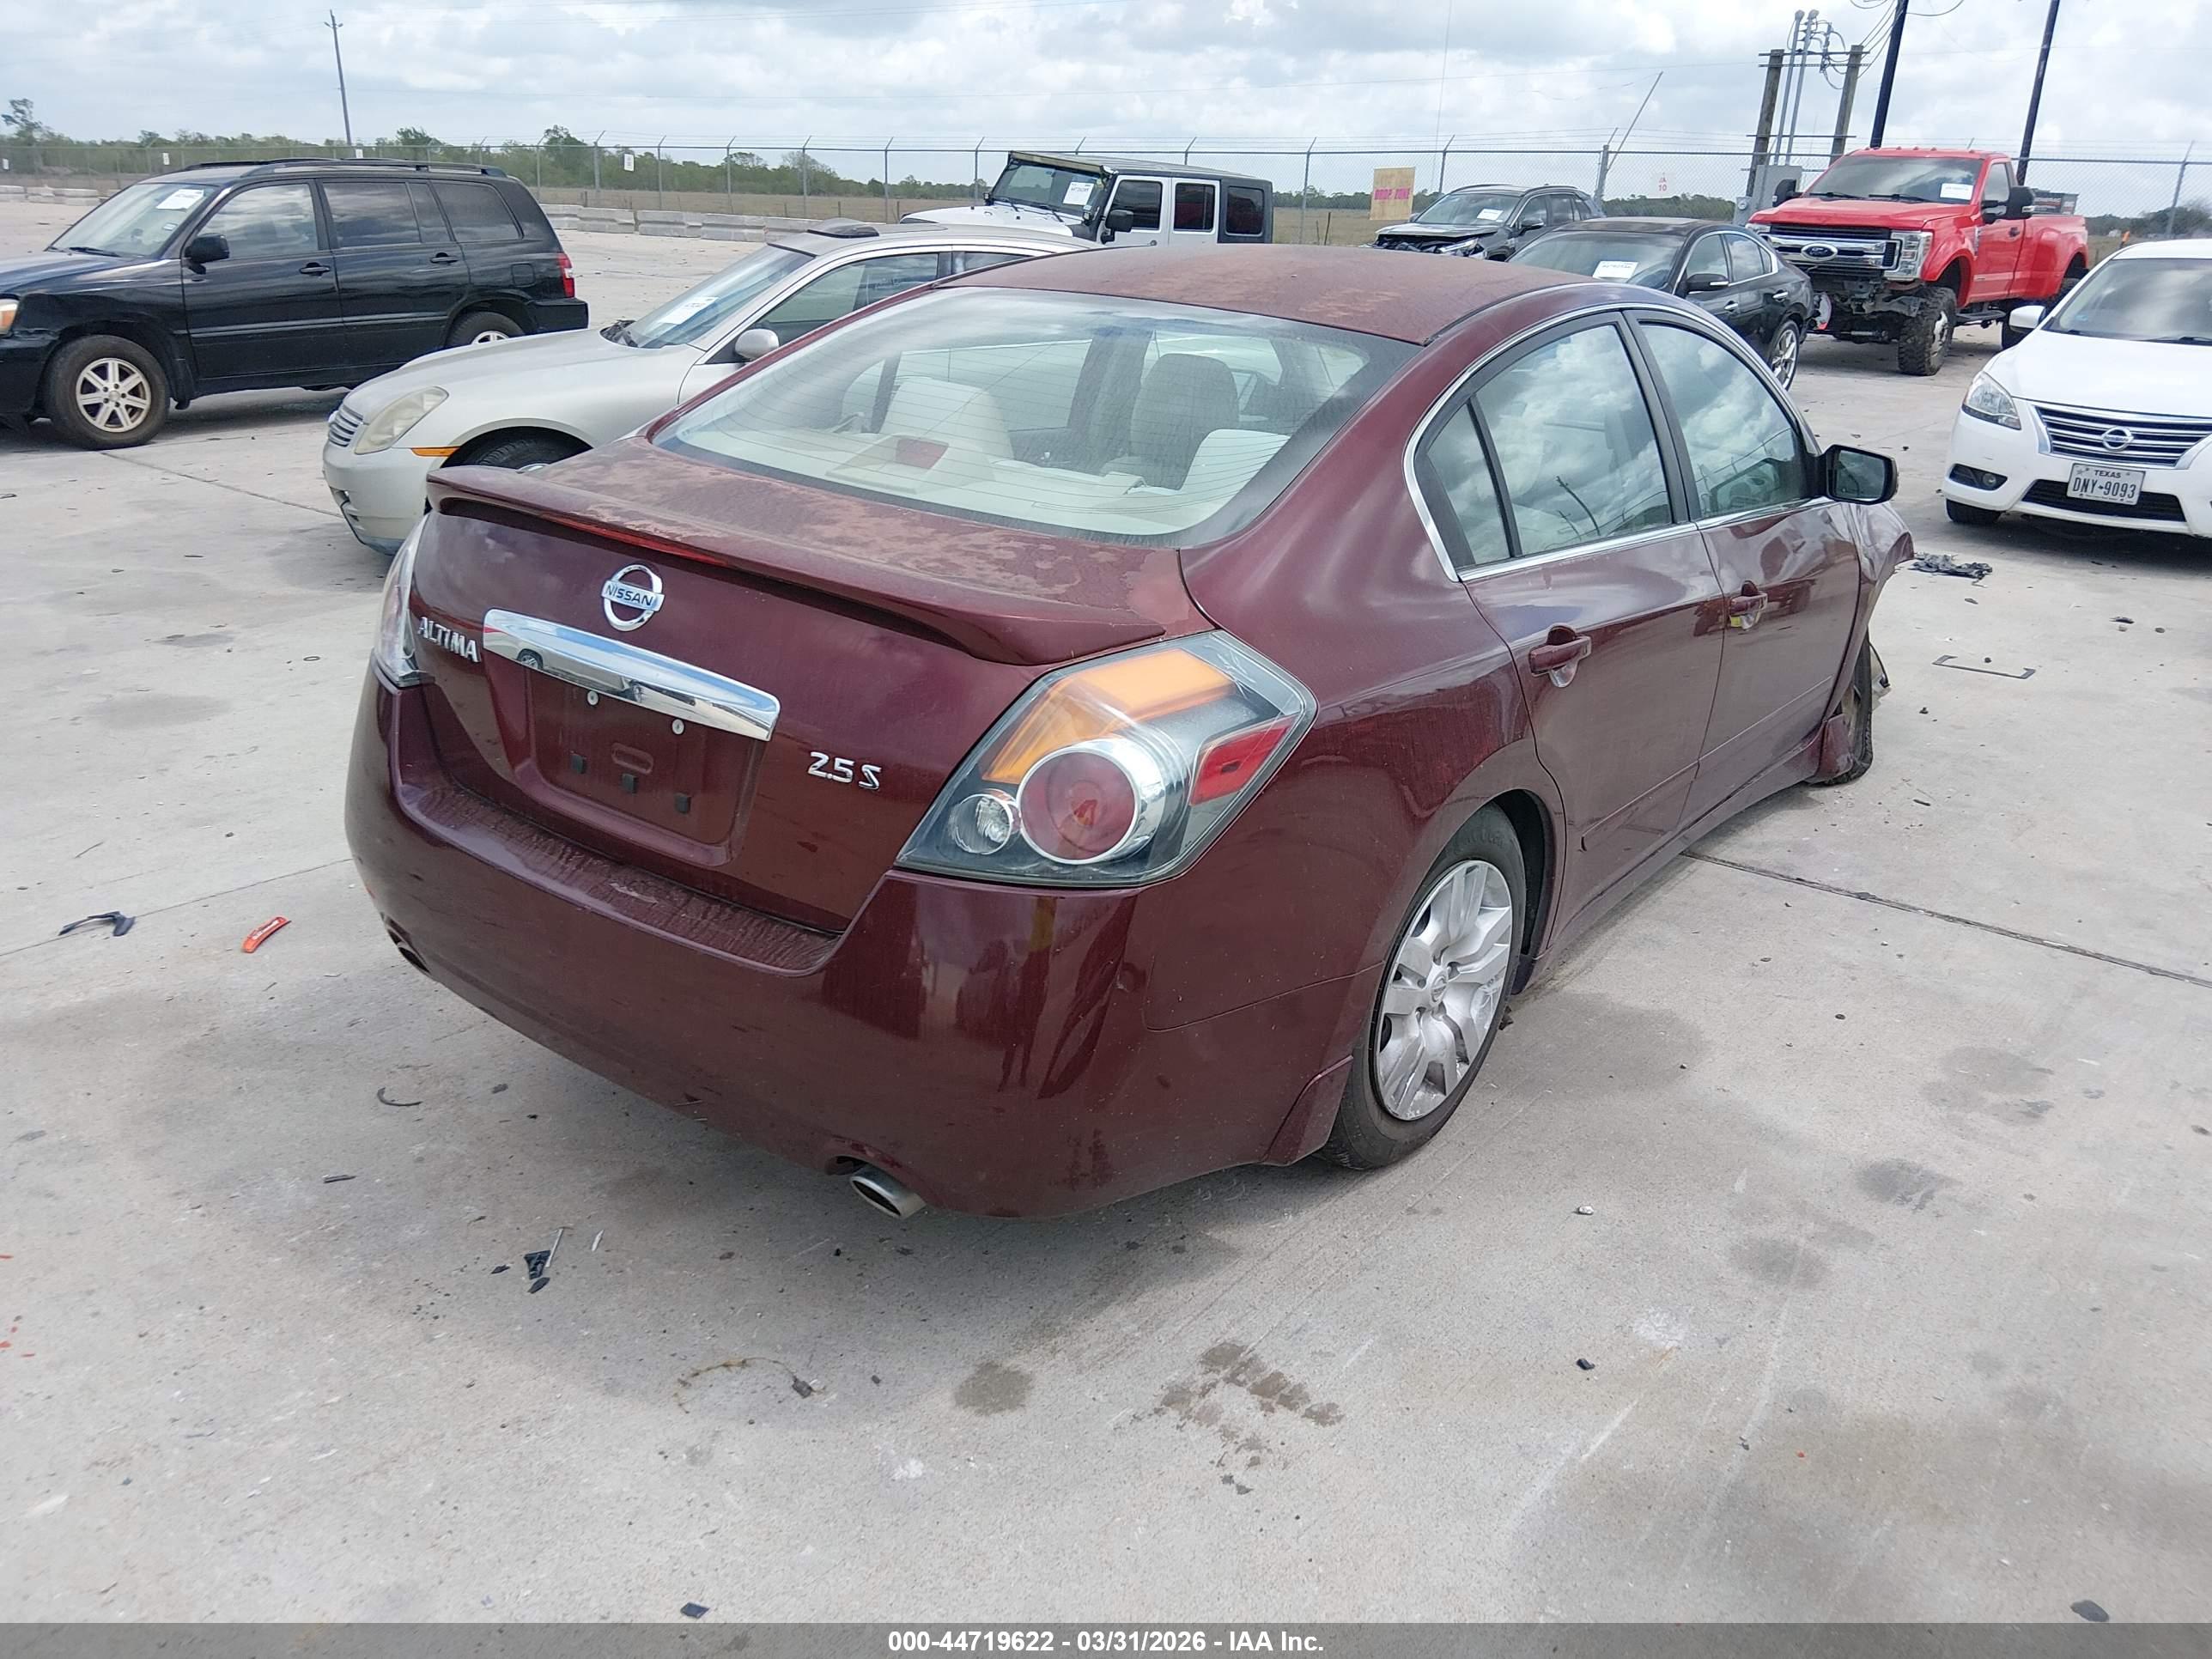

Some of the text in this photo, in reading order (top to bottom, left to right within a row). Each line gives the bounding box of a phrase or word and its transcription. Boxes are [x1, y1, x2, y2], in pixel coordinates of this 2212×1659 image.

[2094, 470, 2121, 478] TEXAS
[605, 584, 653, 606] NISSAN
[417, 616, 479, 663] ALTIMA
[807, 751, 883, 790] 2.5 S
